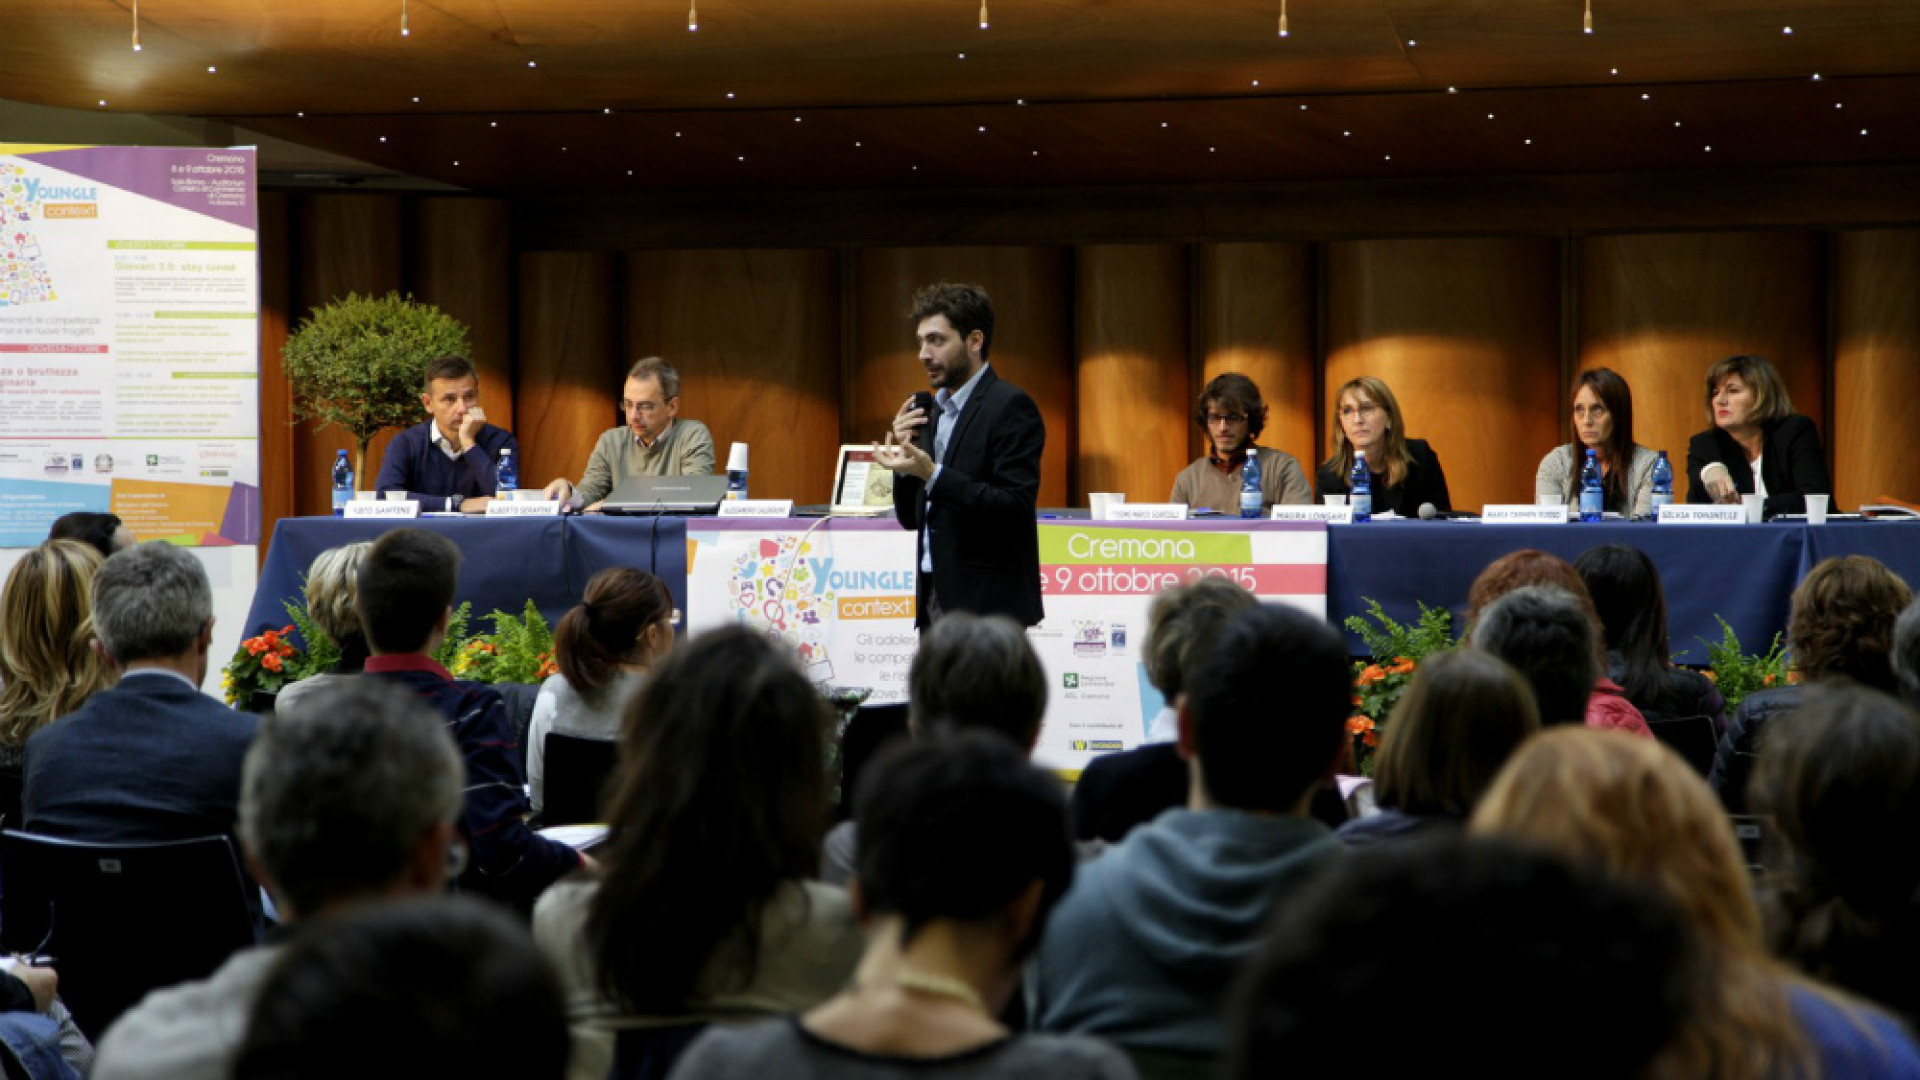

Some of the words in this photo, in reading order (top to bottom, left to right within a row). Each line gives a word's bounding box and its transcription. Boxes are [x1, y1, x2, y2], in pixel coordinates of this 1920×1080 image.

[23, 178, 97, 202] YOUNGLE
[1068, 533, 1195, 559] Cremona
[808, 558, 913, 595] YOUNGLE
[1055, 567, 1072, 592] 9
[1078, 567, 1180, 592] ottobre
[842, 598, 911, 616] context
